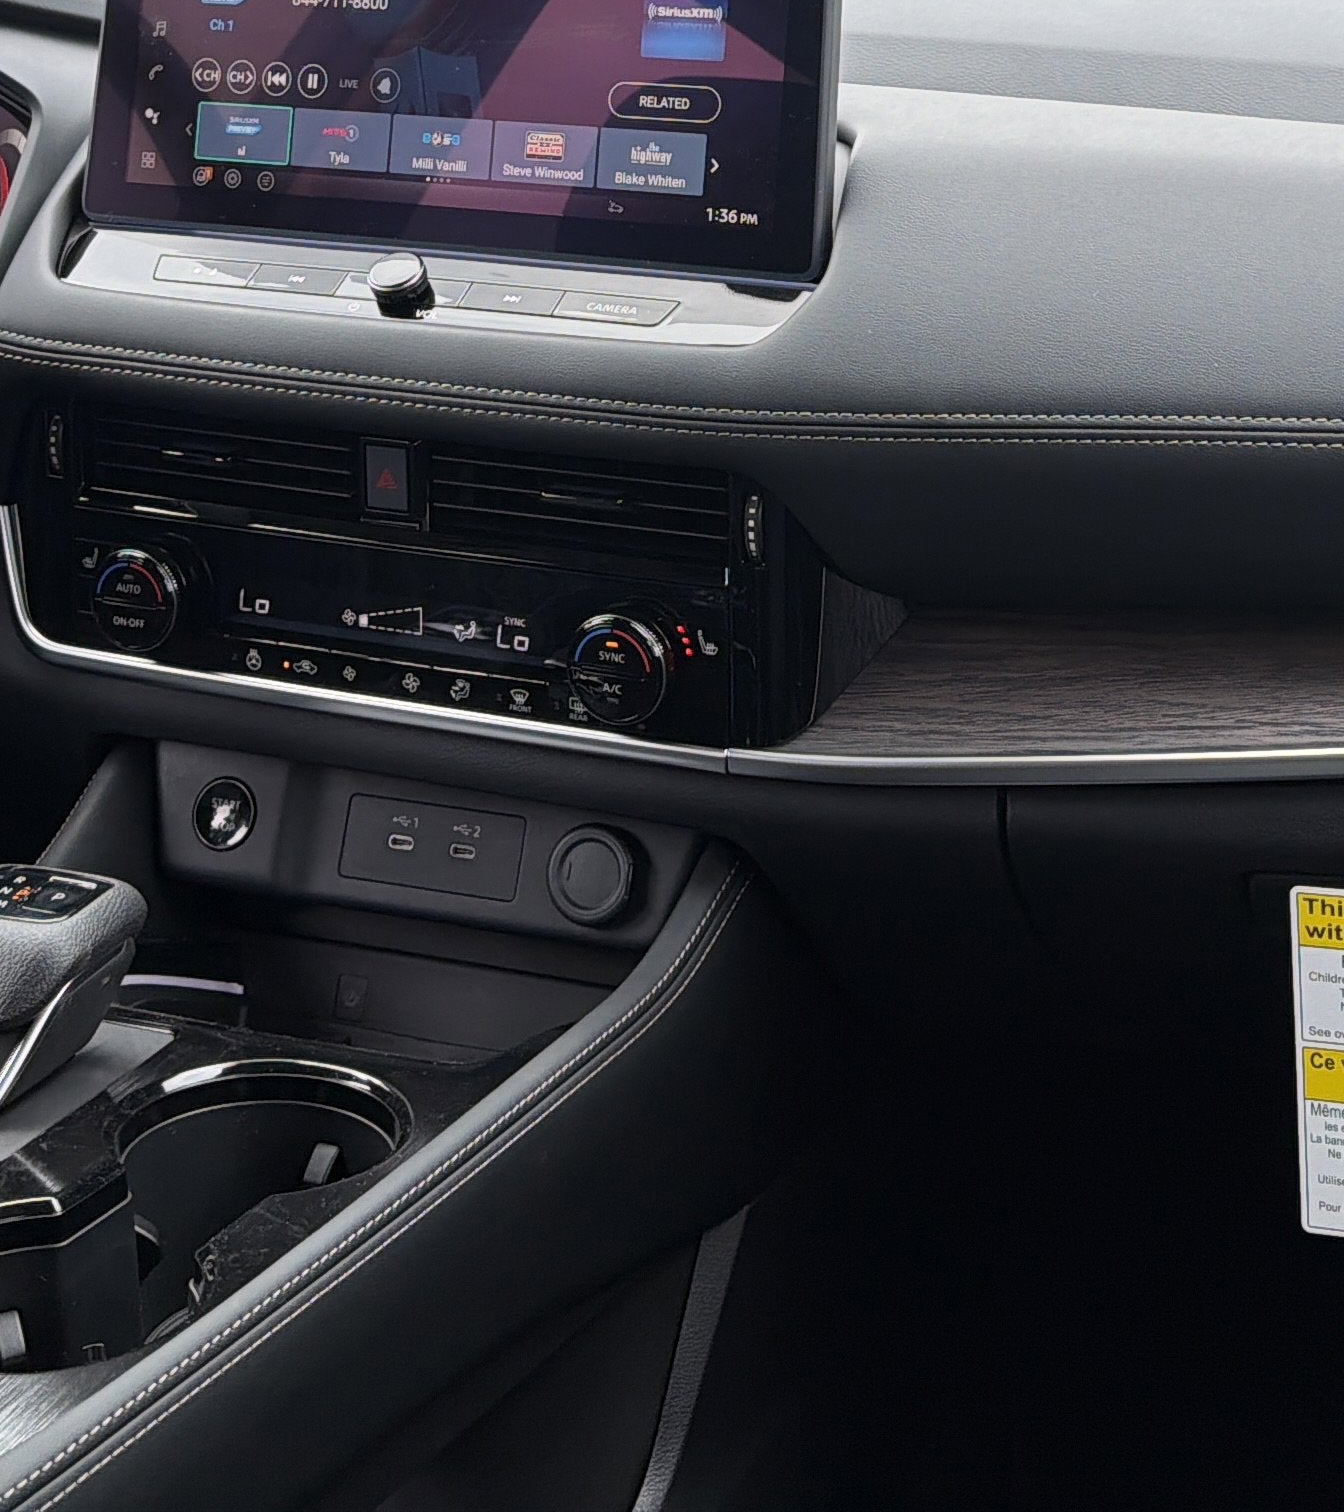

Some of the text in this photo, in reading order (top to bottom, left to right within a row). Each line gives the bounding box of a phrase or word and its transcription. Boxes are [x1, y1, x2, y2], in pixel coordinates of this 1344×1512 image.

[209, 18, 234, 32] Ch 1
[203, 70, 246, 83] CH CH
[339, 78, 359, 89] LIVE
[639, 95, 690, 110] RELATED
[329, 151, 350, 165] Tyla
[631, 146, 672, 166] highway
[412, 157, 467, 172] Milli Vanilli
[503, 164, 584, 181] Steve Winwood
[615, 172, 686, 189] Blake Whiten
[707, 208, 758, 226] 1:36 PM
[415, 308, 439, 321] VOL
[586, 301, 639, 316] CAMERA
[116, 582, 141, 595] AUTO
[239, 587, 270, 614] Lo
[504, 616, 526, 627] SYNC
[496, 624, 530, 652] Lo
[599, 650, 626, 664] SYNC
[602, 682, 623, 695] A/C
[509, 704, 532, 714] FRONT
[568, 713, 588, 722] REAR
[211, 797, 241, 810] START
[413, 817, 419, 828] 1
[472, 826, 481, 837] 2
[51, 892, 66, 901] P
[1308, 1026, 1331, 1038] See
[1310, 1052, 1335, 1071] Ce
